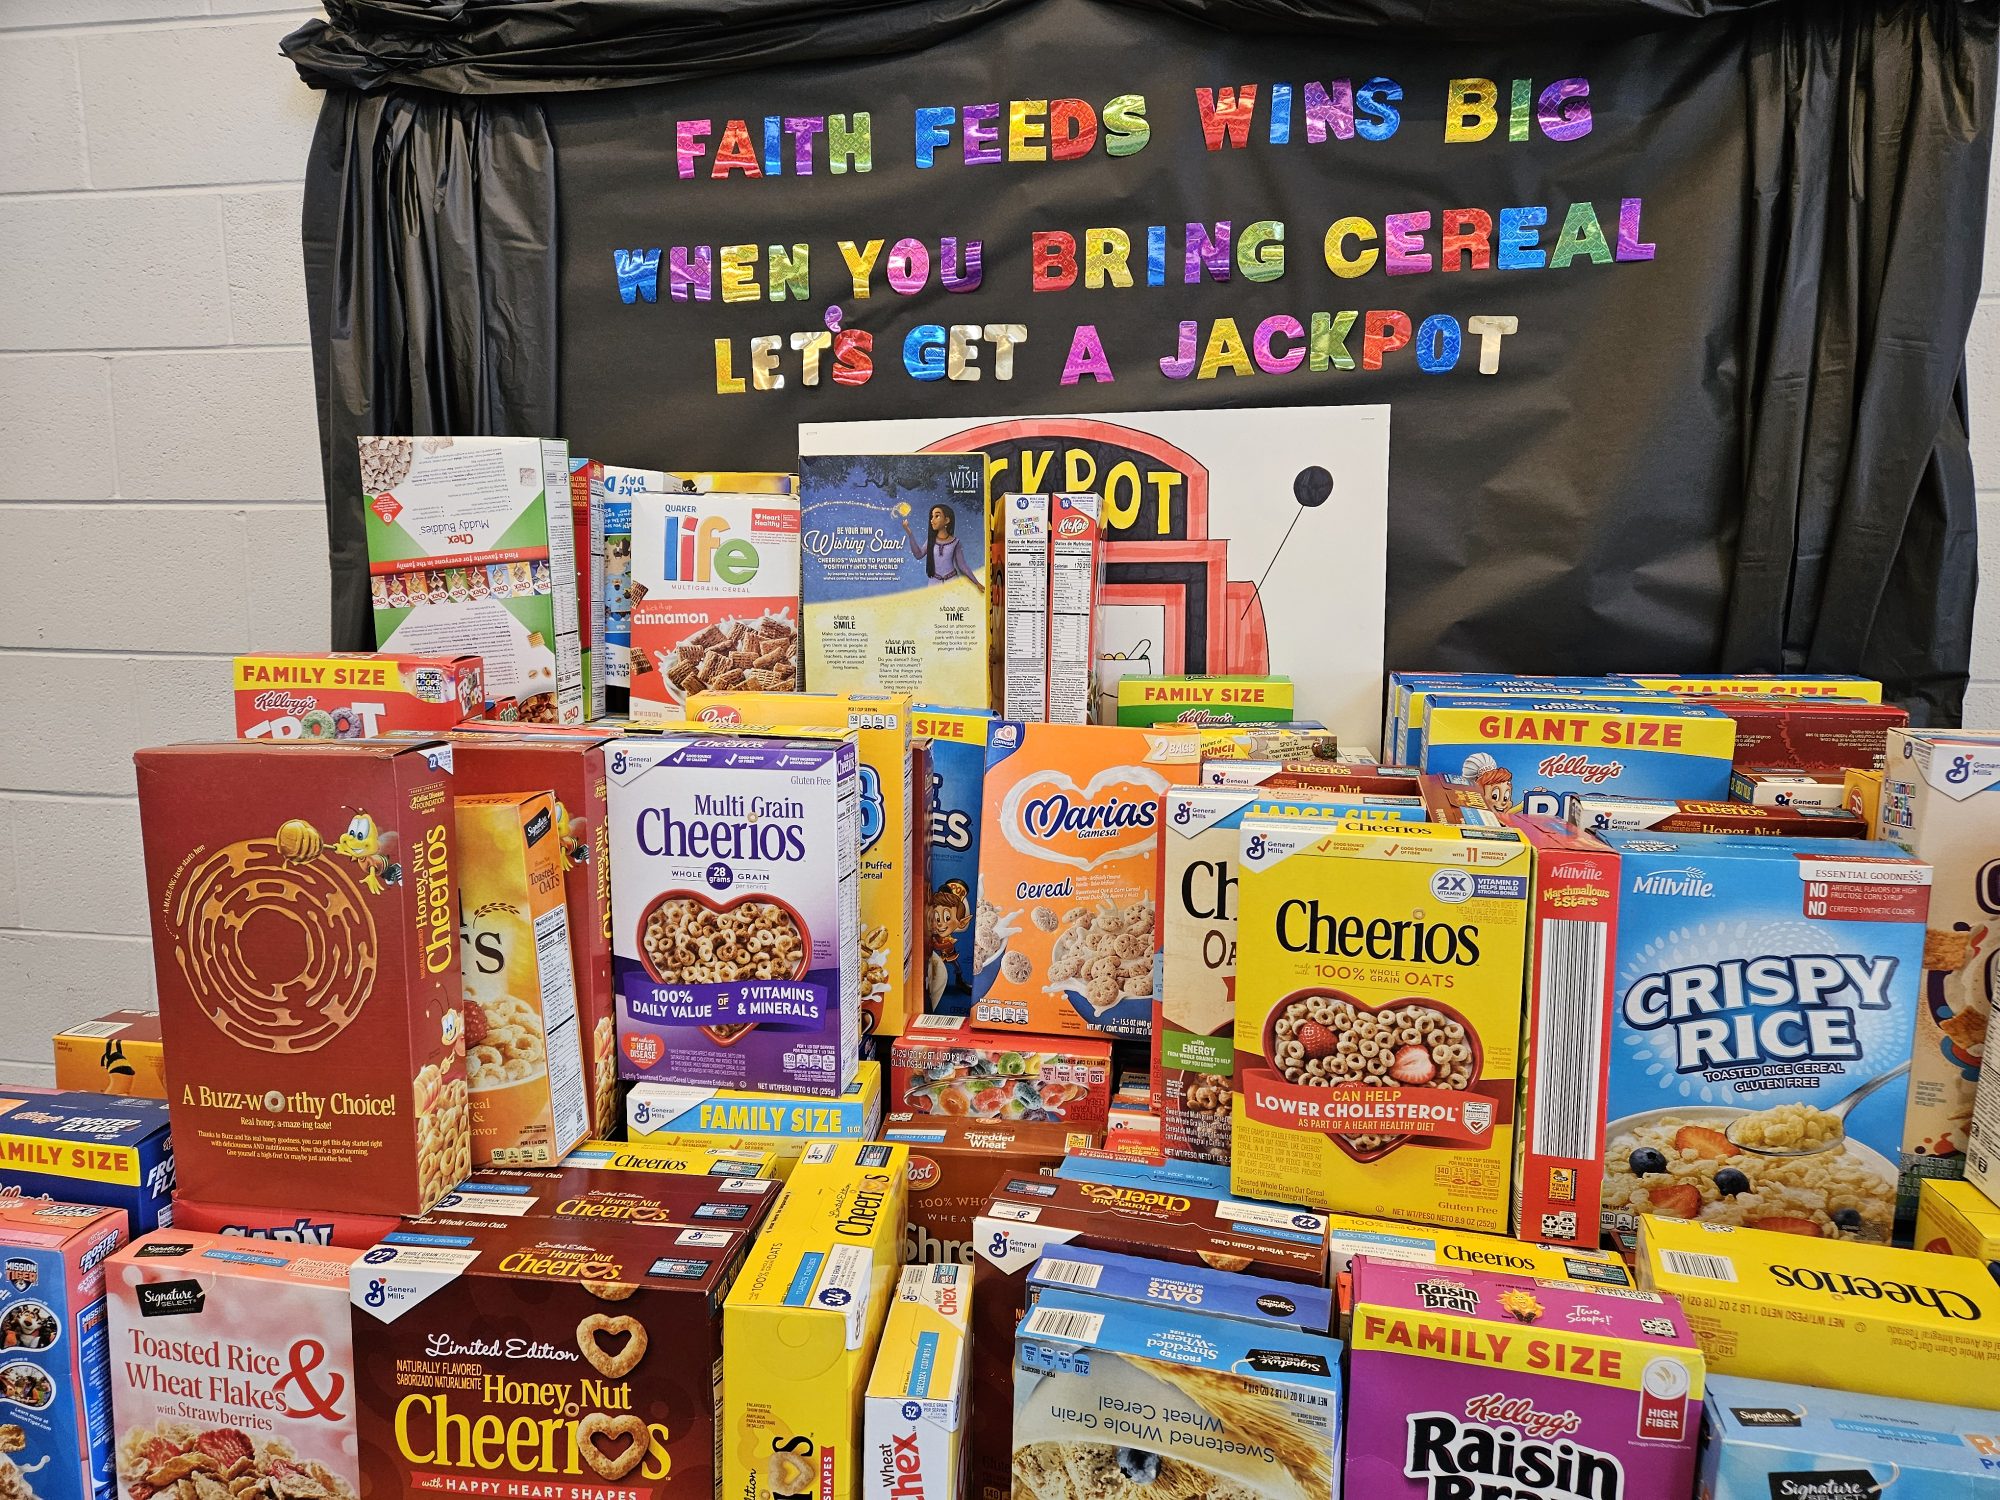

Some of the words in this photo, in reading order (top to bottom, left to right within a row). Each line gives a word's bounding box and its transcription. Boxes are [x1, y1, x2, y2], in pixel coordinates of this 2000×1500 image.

[676, 112, 872, 179] FAITH
[915, 94, 1151, 168] FEEDS
[1195, 77, 1403, 151] WINS
[1445, 77, 1593, 144] BIG
[613, 243, 810, 304] WHEN
[837, 236, 983, 298] YOU
[1032, 220, 1285, 293] BRING
[1324, 198, 1656, 279] CEREAL
[714, 305, 874, 394] LET'S
[903, 324, 1027, 382] GET
[1060, 325, 1115, 385] A
[1159, 310, 1518, 380] JACKPOT
[950, 470, 979, 489] WISH
[665, 504, 696, 513] QUAKER
[421, 523, 456, 535] Buddies
[459, 520, 489, 529] Muddy
[754, 520, 780, 528] Healthy
[1057, 517, 1089, 533] KitKat
[448, 534, 474, 544] Chex
[804, 530, 865, 555] Wishing
[870, 529, 906, 551] Star!
[664, 515, 759, 585] life
[671, 584, 719, 593] MULTIGRAIN
[633, 610, 709, 624] cinnamon
[946, 613, 964, 621] TIME
[885, 646, 916, 654] TALENTS
[243, 665, 325, 683] FAMILY
[334, 669, 385, 685] SIZE
[255, 692, 316, 714] Kellogg's
[1145, 687, 1216, 701] FAMILY
[1221, 688, 1264, 702] SIZE
[917, 719, 964, 737] SIZE
[1480, 716, 1590, 742] GIANT
[1601, 721, 1683, 746] SIZE
[1169, 743, 1196, 754] BAGS
[1539, 754, 1622, 783] Kellogg's
[791, 776, 815, 785] Gluten
[816, 777, 831, 785] Free
[695, 795, 744, 816] Multi
[751, 797, 804, 818] Grain
[1025, 795, 1157, 837] Marias
[636, 808, 805, 861] Cheerios
[1345, 822, 1432, 835] Cheerios
[1268, 841, 1295, 849] General
[412, 841, 424, 872] Nut
[865, 861, 892, 870] Puffed
[709, 876, 730, 884] grams
[714, 867, 726, 876] 28
[1816, 870, 1868, 879] ESSENTIAL
[1870, 872, 1918, 881] GOODNESS
[951, 884, 965, 897] POP
[1017, 877, 1073, 900] Cereal
[1437, 876, 1467, 891] 2X
[1633, 876, 1714, 898] Millville
[1810, 883, 1828, 897] NO
[416, 879, 428, 929] Honey
[425, 823, 452, 974] Cheerios
[1809, 901, 1826, 915] NO
[1276, 898, 1480, 966] Cheerios
[1314, 964, 1365, 982] 100%
[1404, 971, 1454, 988] OATS
[1369, 968, 1400, 976] WHOLE
[1369, 975, 1400, 984] GRAIN
[652, 989, 693, 1003] 100%
[741, 989, 749, 999] 9
[751, 986, 814, 1002] VITAMINS
[1623, 956, 1898, 1030] CRISPY
[633, 1001, 667, 1017] DAILY
[671, 1004, 712, 1017] VALUE
[737, 1004, 746, 1015] &
[750, 1002, 818, 1018] MINERALS
[1674, 1007, 1862, 1073] RICE
[1183, 1044, 1216, 1056] ENERGY
[1704, 1066, 1760, 1082] TOASTED
[1763, 1064, 1792, 1076] RICE
[1795, 1062, 1844, 1075] CEREAL
[1734, 1079, 1785, 1092] GLUTEN
[1788, 1077, 1819, 1088] FREE
[182, 1084, 195, 1106] A
[330, 1093, 396, 1116] Choice!
[1255, 1092, 1320, 1118] LOWER
[1333, 1091, 1362, 1101] CAN
[1366, 1092, 1401, 1101] HELP
[241, 1117, 254, 1126] Real
[256, 1118, 276, 1128] honey,
[277, 1120, 313, 1130] a-maze-ing
[314, 1121, 332, 1130] taste!
[700, 1105, 787, 1129] FAMILY
[791, 1109, 842, 1132] SIZE
[1311, 1119, 1330, 1129] PART
[1333, 1120, 1342, 1129] OF
[1344, 1121, 1350, 1129] A
[1352, 1122, 1378, 1130] HEART
[1380, 1122, 1415, 1131] HEALTHY
[1417, 1122, 1435, 1132] DIET
[964, 1132, 1015, 1142] Shredded
[970, 1139, 1006, 1149] Wheat
[72, 1149, 129, 1172] SIZE
[614, 1155, 688, 1170] Cheerios
[5, 1261, 37, 1272] MISSION
[1443, 1244, 1536, 1271] Cheerios
[6, 1270, 37, 1282] TIGER
[145, 1289, 193, 1307] Signature
[387, 1285, 417, 1294] General
[387, 1292, 405, 1300] Mills
[1416, 1282, 1479, 1303] Raisin
[1768, 1264, 1982, 1321] Cheerios
[161, 1298, 194, 1307] SELECT
[1424, 1293, 1476, 1314] Bran
[425, 1333, 502, 1358] Limited
[505, 1338, 579, 1362] Edition
[1364, 1316, 1512, 1363] FAMILY
[1527, 1341, 1621, 1379] SIZE
[128, 1327, 220, 1367] Toasted
[227, 1344, 280, 1375] Rice
[273, 1339, 346, 1421] &
[396, 1360, 441, 1373] NATURALLY
[442, 1362, 482, 1376] FLAVORED
[125, 1361, 204, 1400] Wheat
[209, 1376, 287, 1412] Flakes
[482, 1373, 572, 1415] Honey
[581, 1379, 632, 1410] Nut
[157, 1404, 176, 1415] with
[178, 1402, 273, 1431] Strawberries
[1100, 1396, 1155, 1419] Cereal
[1468, 1395, 1579, 1438] Kellogg's
[1648, 1408, 1678, 1419] HIGH
[1051, 1405, 1097, 1429] Grain
[1163, 1409, 1225, 1435] Wheat
[1645, 1417, 1679, 1429] FIBER
[1104, 1419, 1163, 1441] Whole
[1169, 1430, 1275, 1463] Sweetened
[882, 1443, 896, 1487] Wheat
[1412, 1417, 1618, 1500] Raisin
[421, 1477, 443, 1490] with
[446, 1479, 500, 1495] HAPPY
[508, 1483, 563, 1498] HEART
[571, 1488, 636, 1500] SHAPES
[1780, 1480, 1863, 1496] Signature
